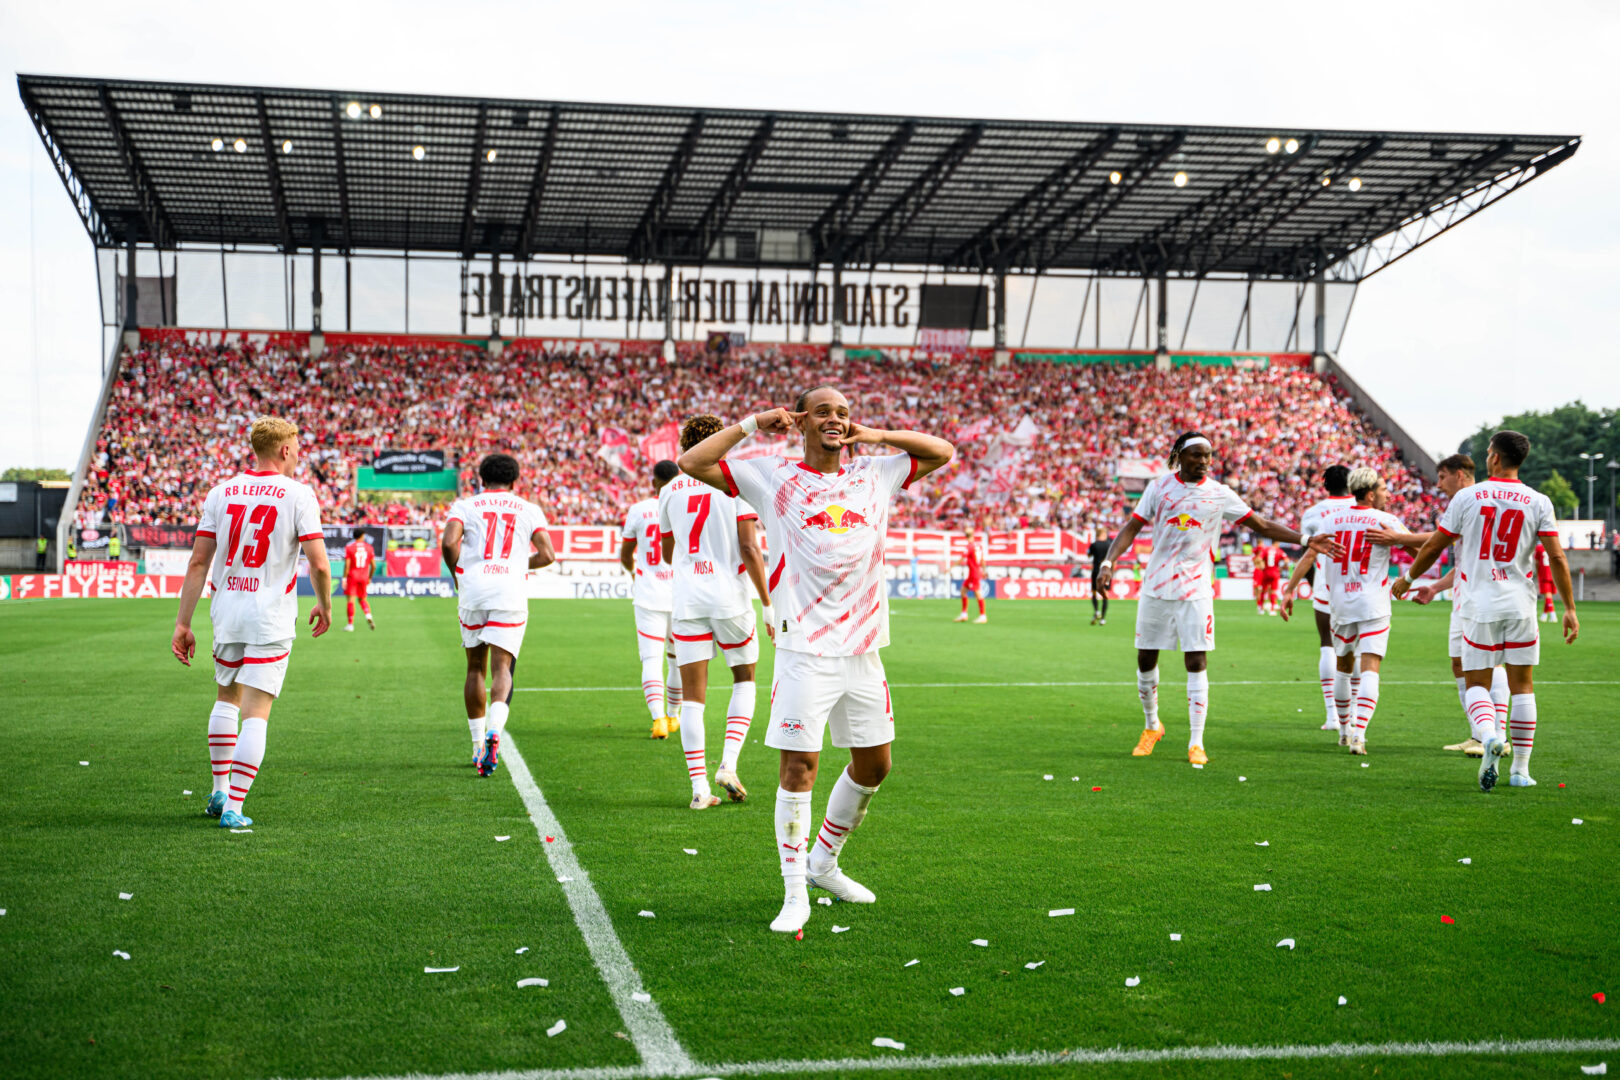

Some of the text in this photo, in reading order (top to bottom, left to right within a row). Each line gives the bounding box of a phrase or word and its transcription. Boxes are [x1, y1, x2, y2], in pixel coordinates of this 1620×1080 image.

[225, 485, 286, 499] RB LEIPZIG
[672, 480, 684, 491] RB
[474, 499, 523, 511] RB LEIPZIG
[1475, 489, 1531, 505] RB LEIPZIG
[687, 493, 711, 554] 7
[1334, 515, 1377, 526] RB LEIPZIG
[225, 504, 278, 568] 13
[482, 511, 517, 560] 11
[1479, 506, 1525, 563] 19
[1333, 530, 1373, 575] 44
[694, 561, 714, 574] NUSA
[571, 582, 635, 598] TARG
